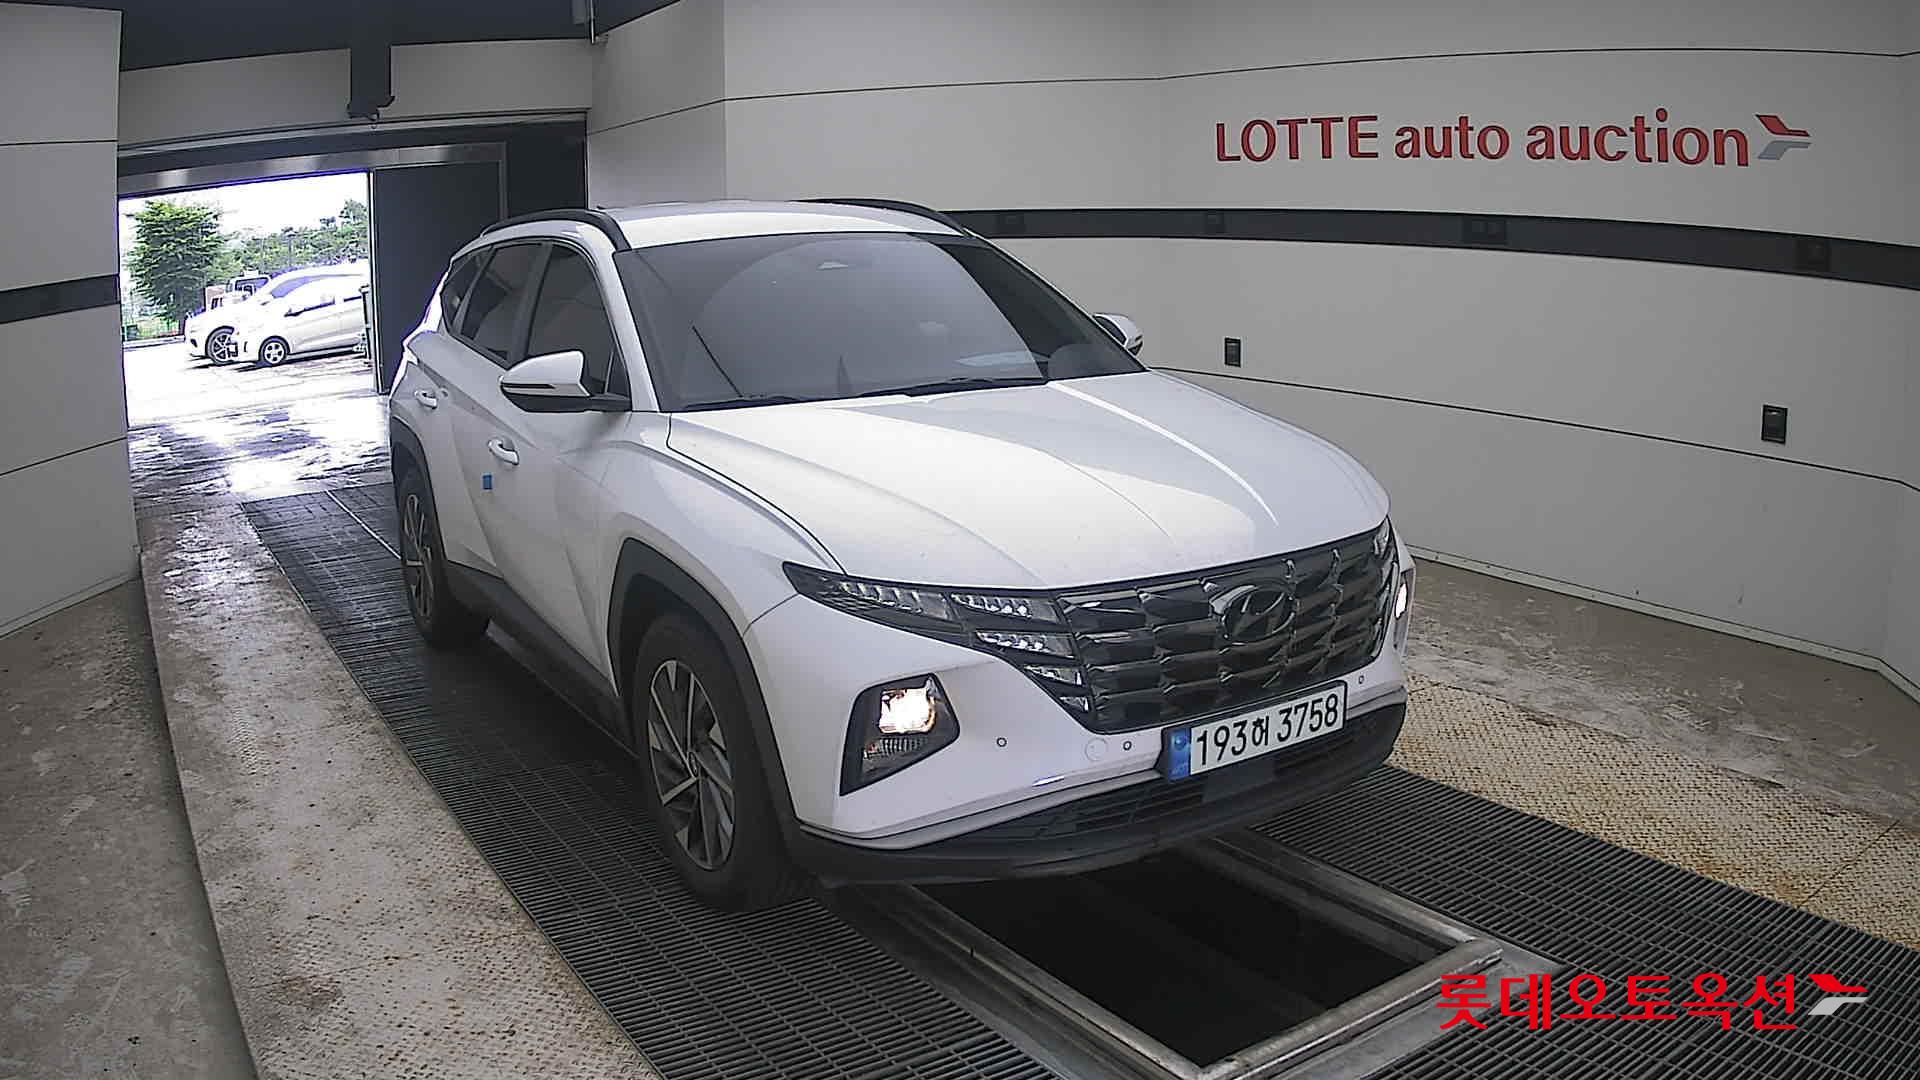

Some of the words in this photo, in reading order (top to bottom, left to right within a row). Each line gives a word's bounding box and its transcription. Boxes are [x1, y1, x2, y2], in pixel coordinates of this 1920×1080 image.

[1216, 115, 1379, 162] LOTTE
[1394, 115, 1510, 160] auto
[1526, 108, 1750, 167] auction
[1196, 715, 1270, 767] 193허
[1277, 693, 1339, 743] 3758
